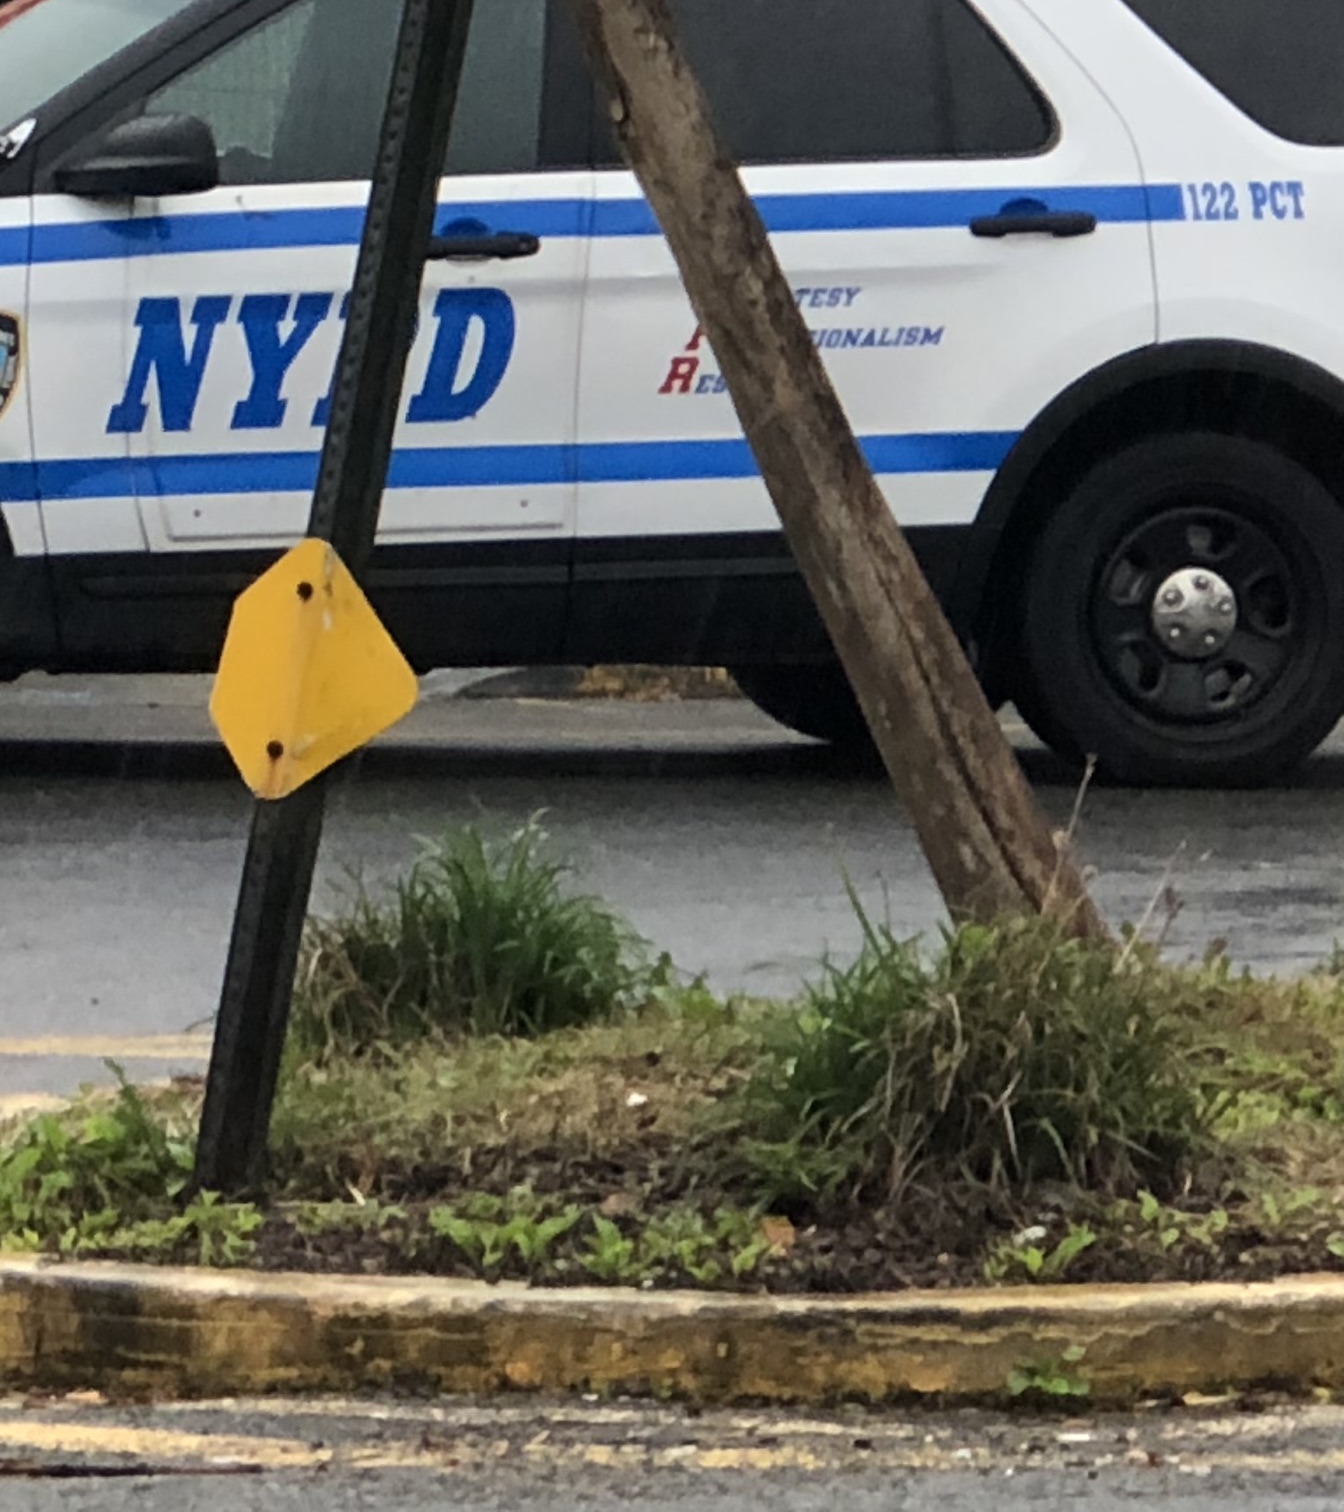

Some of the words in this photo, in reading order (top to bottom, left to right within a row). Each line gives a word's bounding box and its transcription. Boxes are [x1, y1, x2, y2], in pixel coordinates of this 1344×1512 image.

[1187, 181, 1239, 221] 122
[1248, 180, 1305, 220] PCT
[106, 287, 516, 434] NYD
